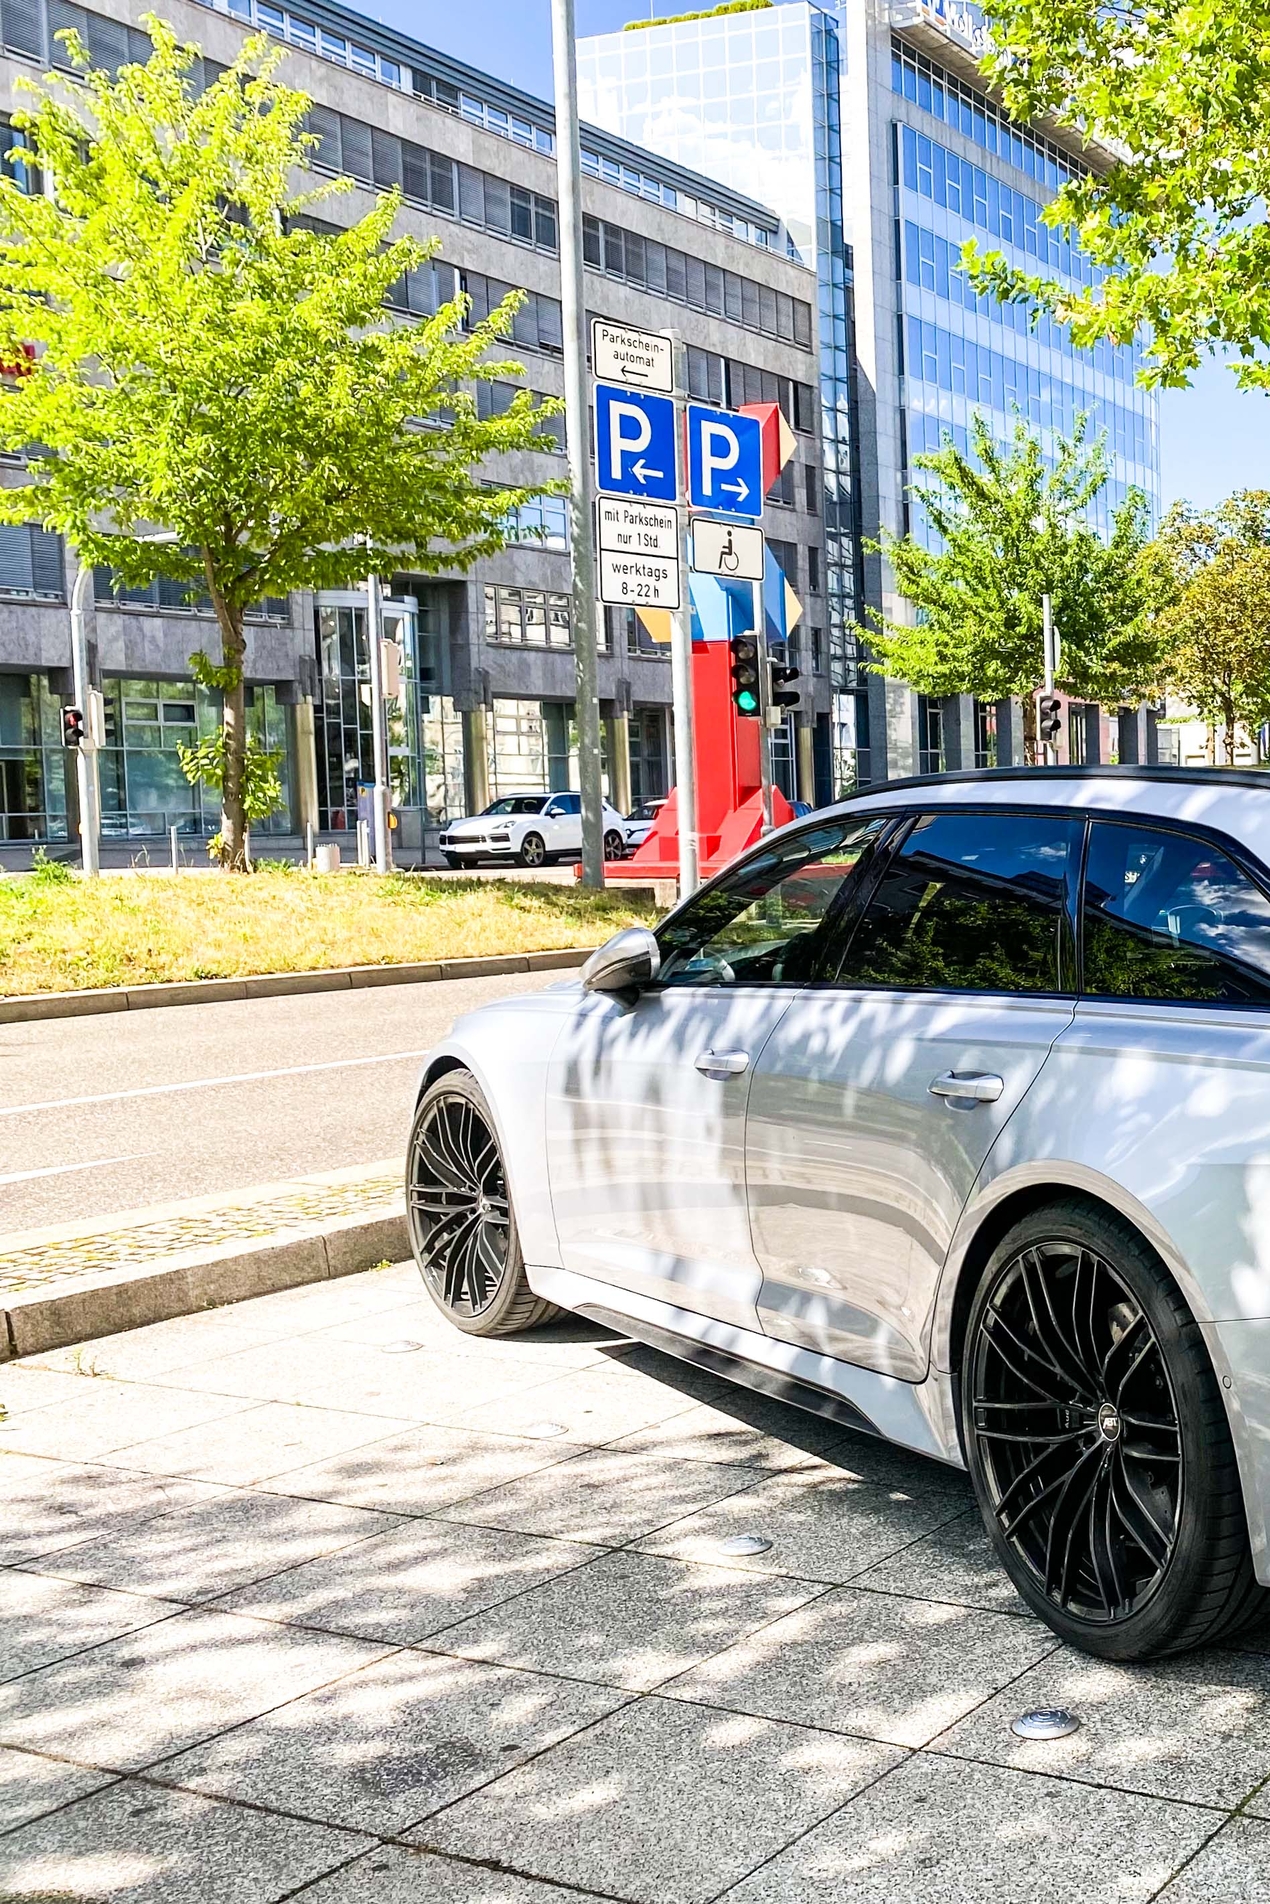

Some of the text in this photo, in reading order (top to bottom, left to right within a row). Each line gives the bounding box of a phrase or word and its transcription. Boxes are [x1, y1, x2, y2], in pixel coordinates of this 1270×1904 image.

[602, 329, 665, 353] Parkschein-
[613, 350, 655, 368] automat
[609, 399, 652, 480] P
[700, 419, 740, 497] P
[604, 508, 672, 530] mit Parkschein
[617, 533, 632, 545] nur
[611, 562, 668, 582] werktags
[653, 585, 660, 598] h
[1102, 1417, 1118, 1429] ABT
